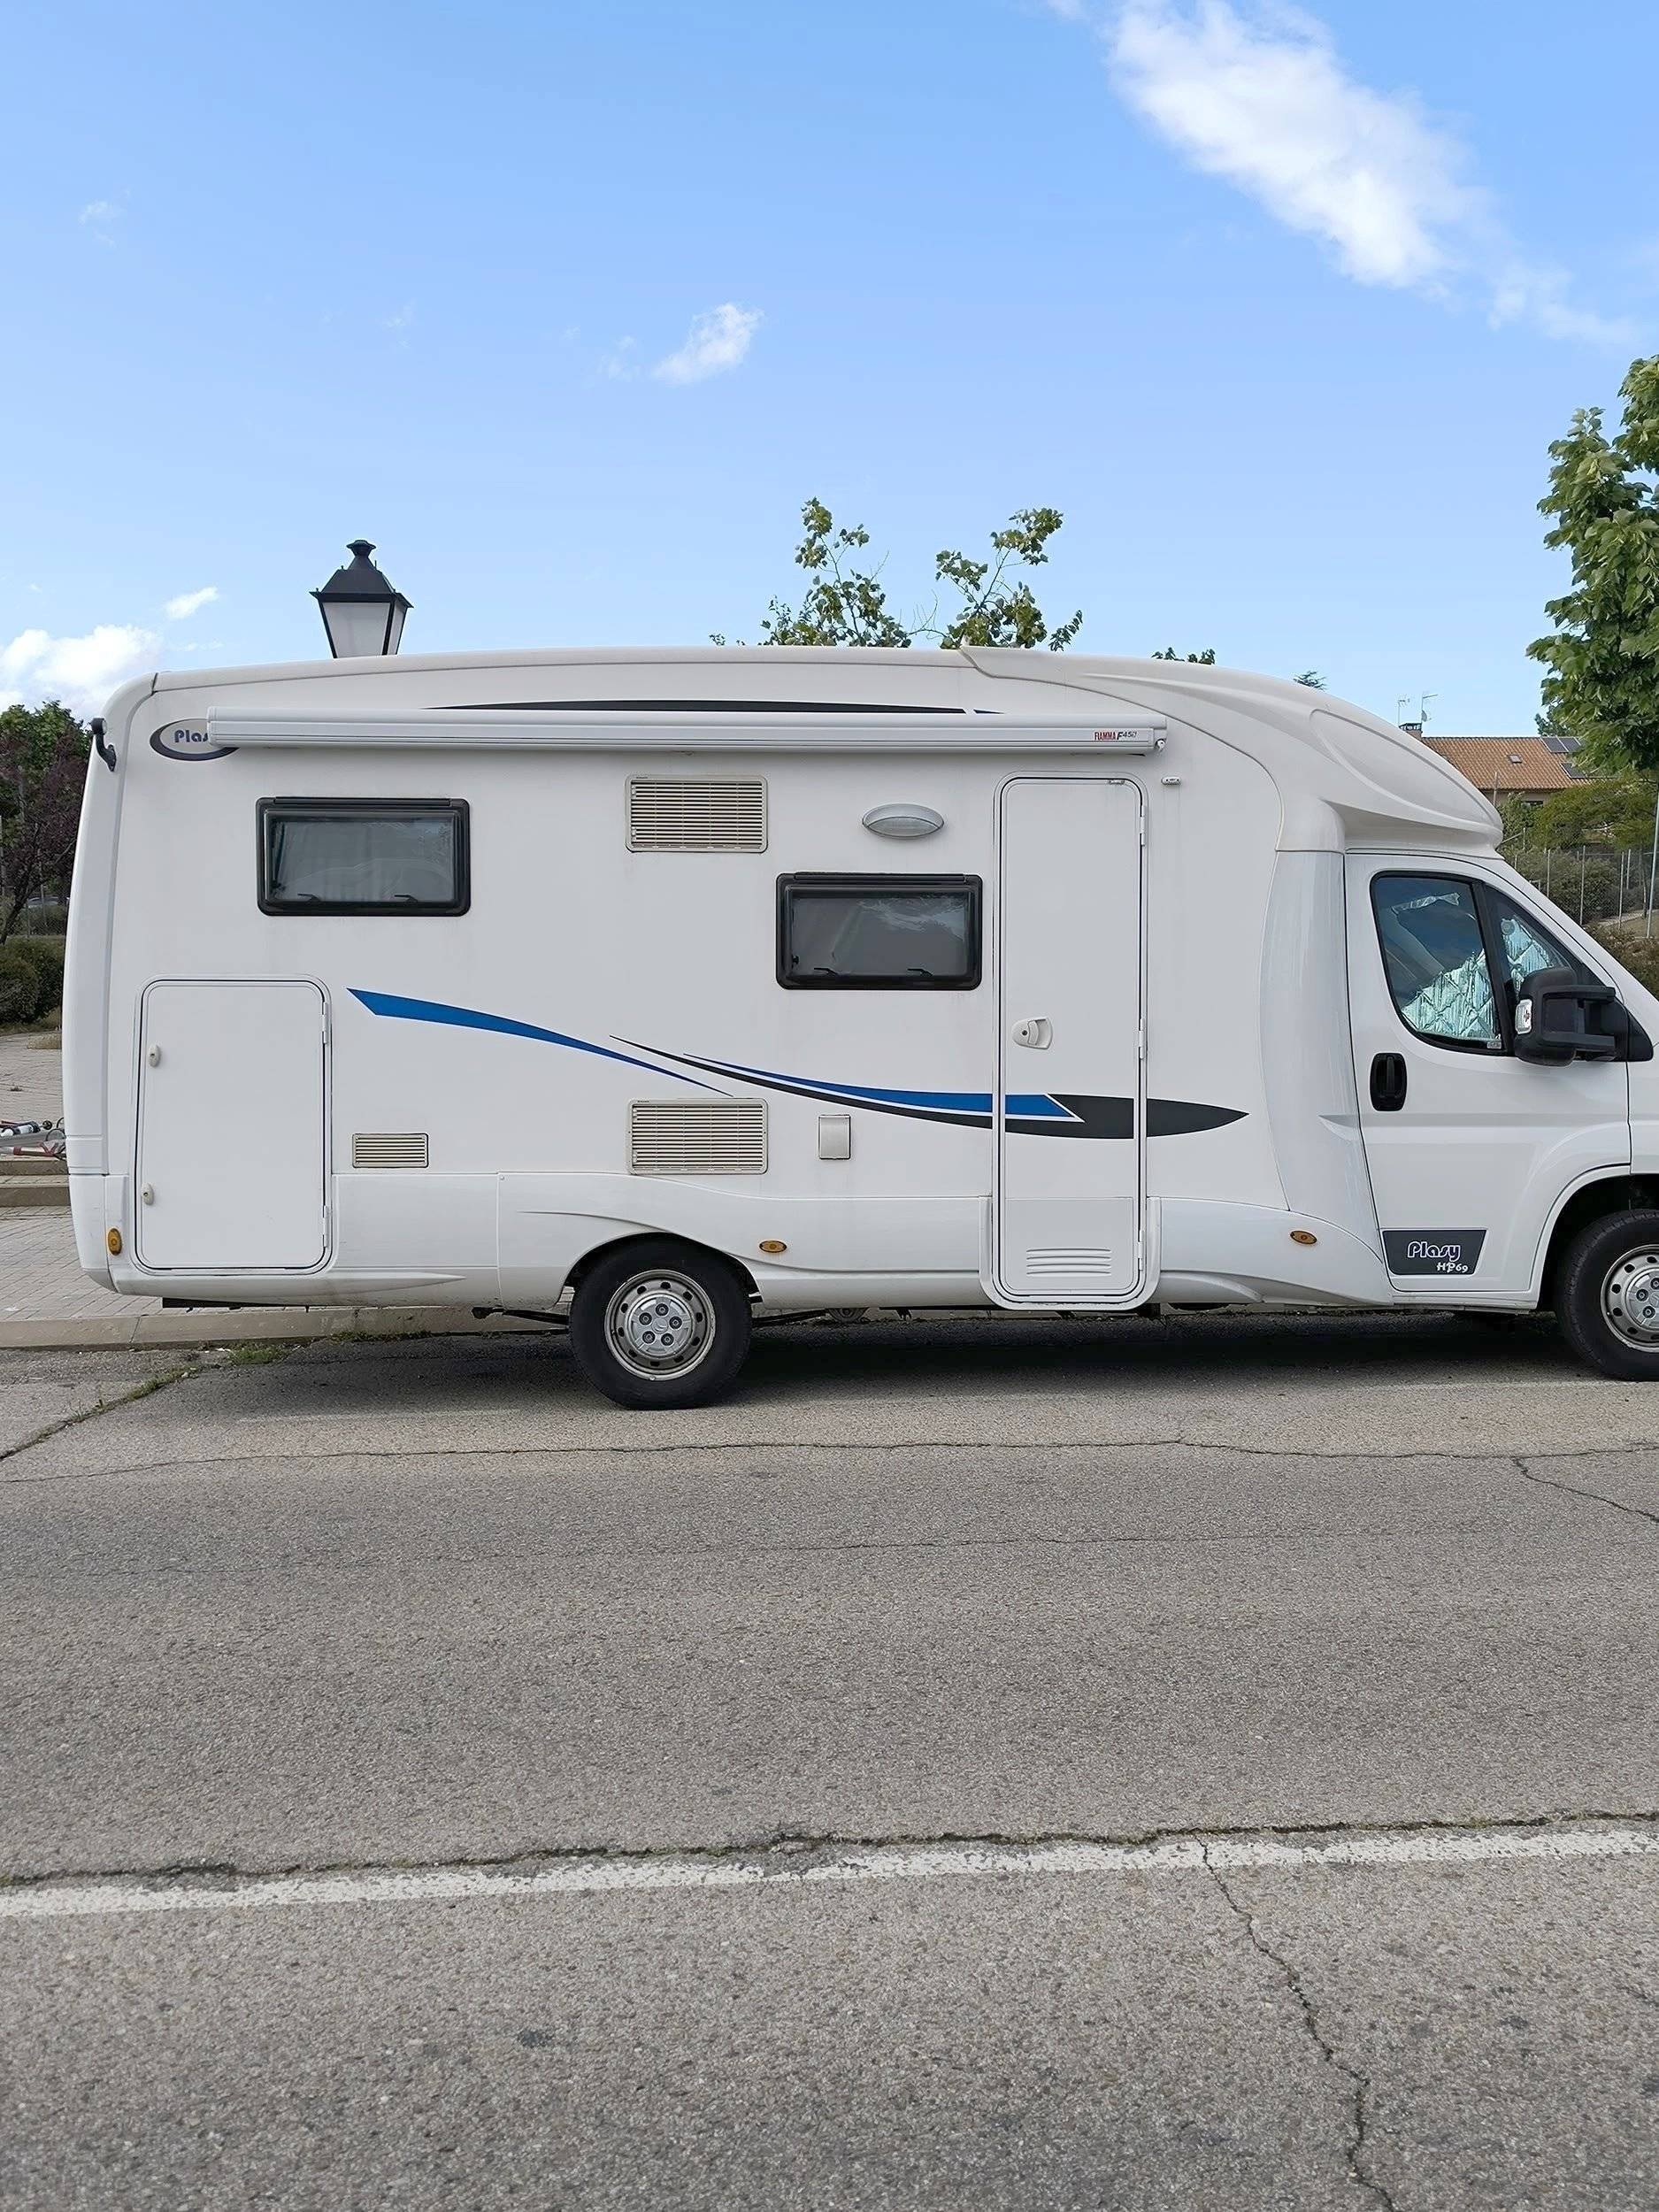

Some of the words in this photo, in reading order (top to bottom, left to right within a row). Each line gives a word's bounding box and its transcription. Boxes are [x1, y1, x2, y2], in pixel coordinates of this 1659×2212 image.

[1094, 731, 1116, 741] FIAMMA
[1408, 1241, 1461, 1262] Plasy
[1436, 1263, 1469, 1273] HP69
